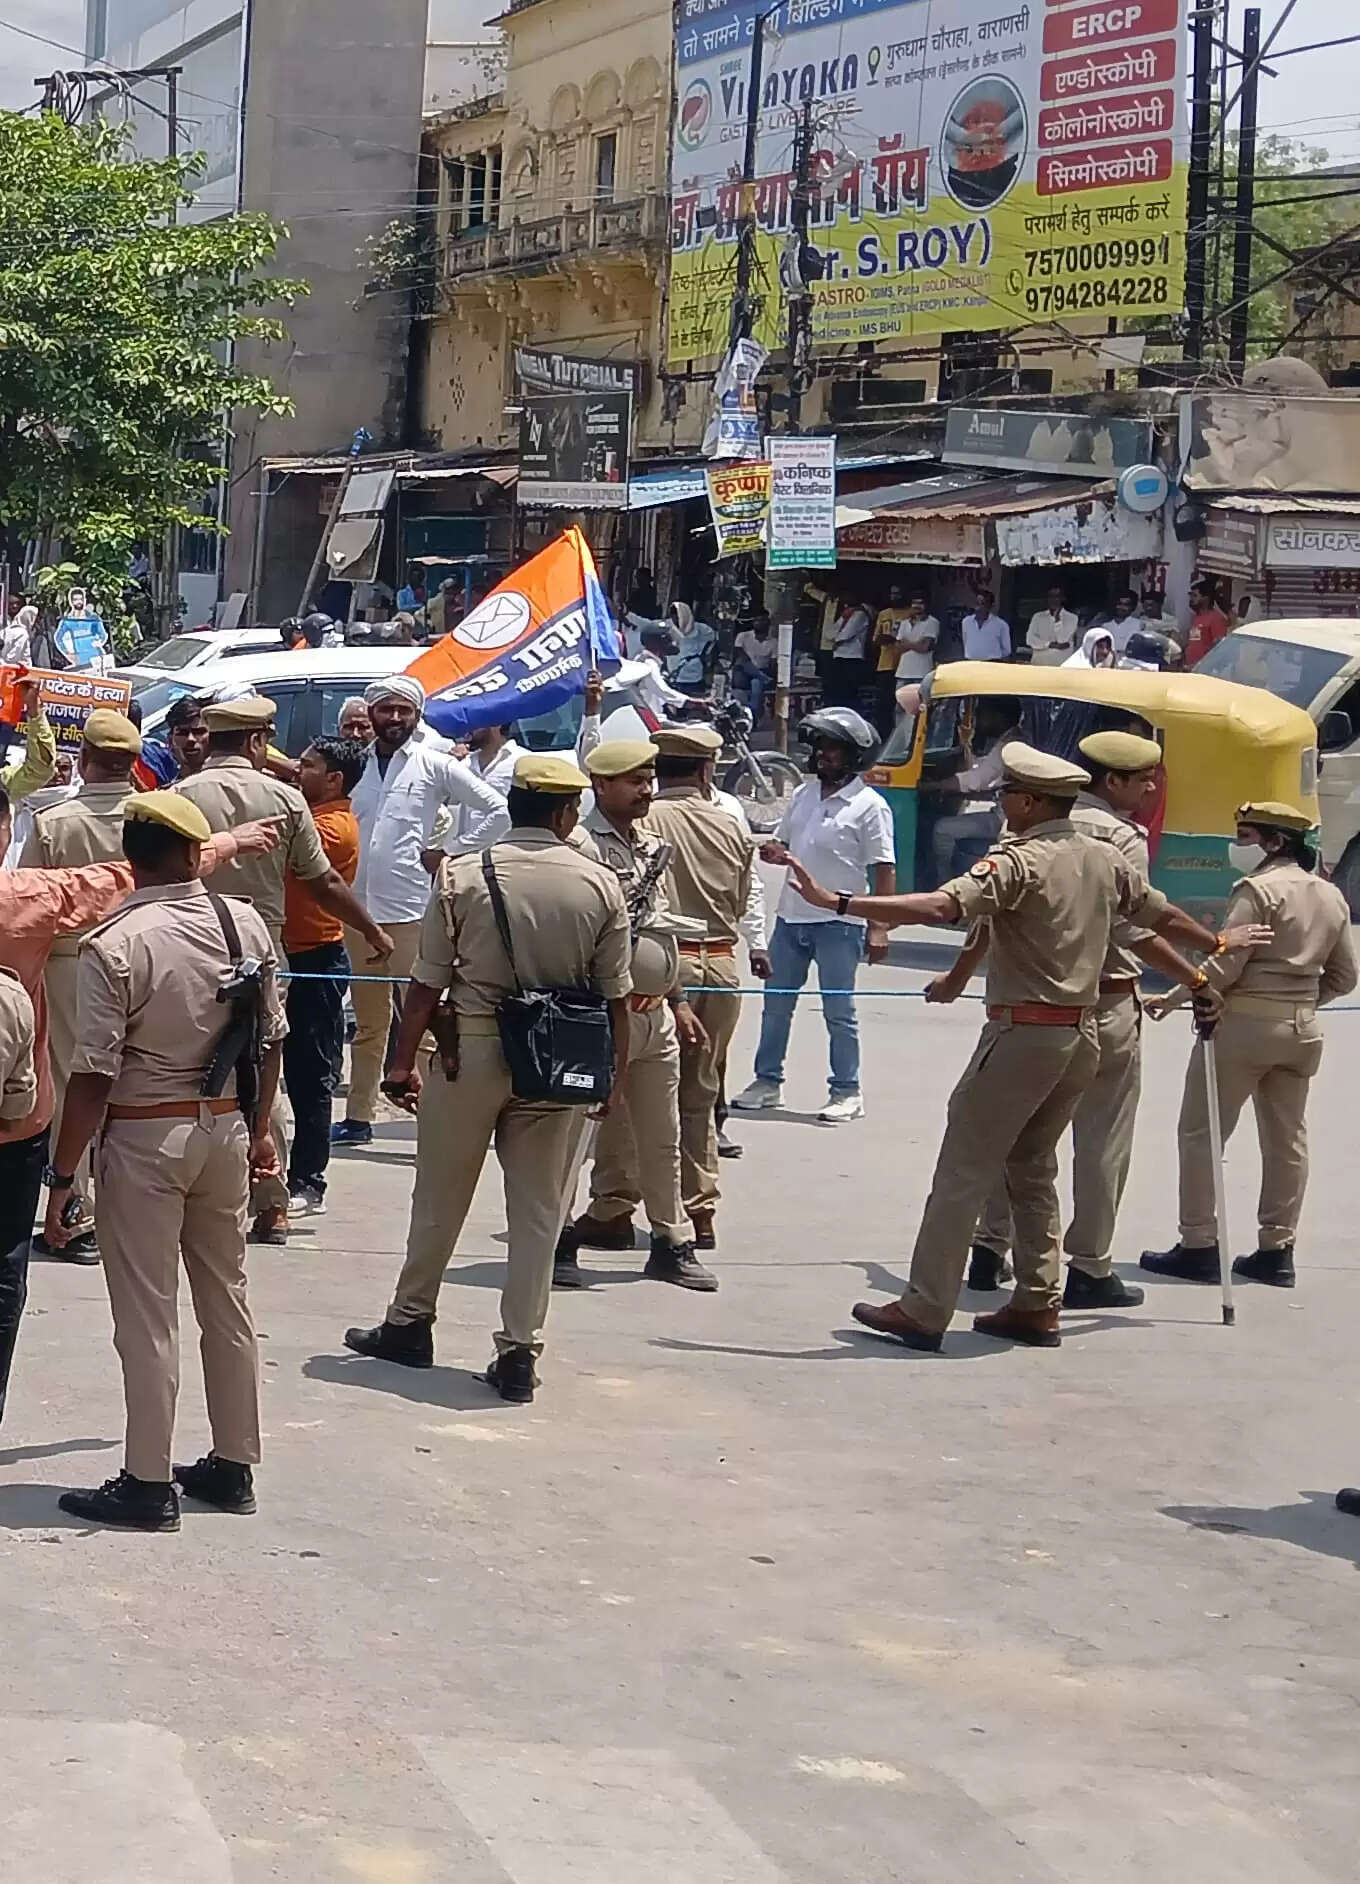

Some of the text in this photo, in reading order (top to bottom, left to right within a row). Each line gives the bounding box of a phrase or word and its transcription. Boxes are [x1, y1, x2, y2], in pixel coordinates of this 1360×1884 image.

[683, 15, 740, 58] तो सामने
[931, 23, 972, 50] चौराहा,
[977, 3, 1031, 40] वाराणसी
[1072, 6, 1142, 39] ERCP
[720, 53, 858, 120] VIAYAKA
[1055, 49, 1157, 93] एण्डोस्कोपी
[720, 115, 764, 143] GASTO
[1044, 95, 1164, 142] कोलोनोस्कोपी
[872, 133, 931, 218] रॉय
[1025, 192, 1171, 236] परामर्श हेतु सम्पर्क करें
[858, 217, 992, 278] S. ROY)
[1025, 234, 1170, 278] 7570009991
[1025, 276, 1168, 314] 9794284228
[859, 320, 901, 336] IMS BHU
[551, 354, 633, 390] TUTORIALS
[967, 413, 1005, 437] Amul
[784, 462, 833, 480] कनिष्क
[46, 677, 125, 702] पटेल के हत्या
[43, 702, 81, 719] भाजपा
